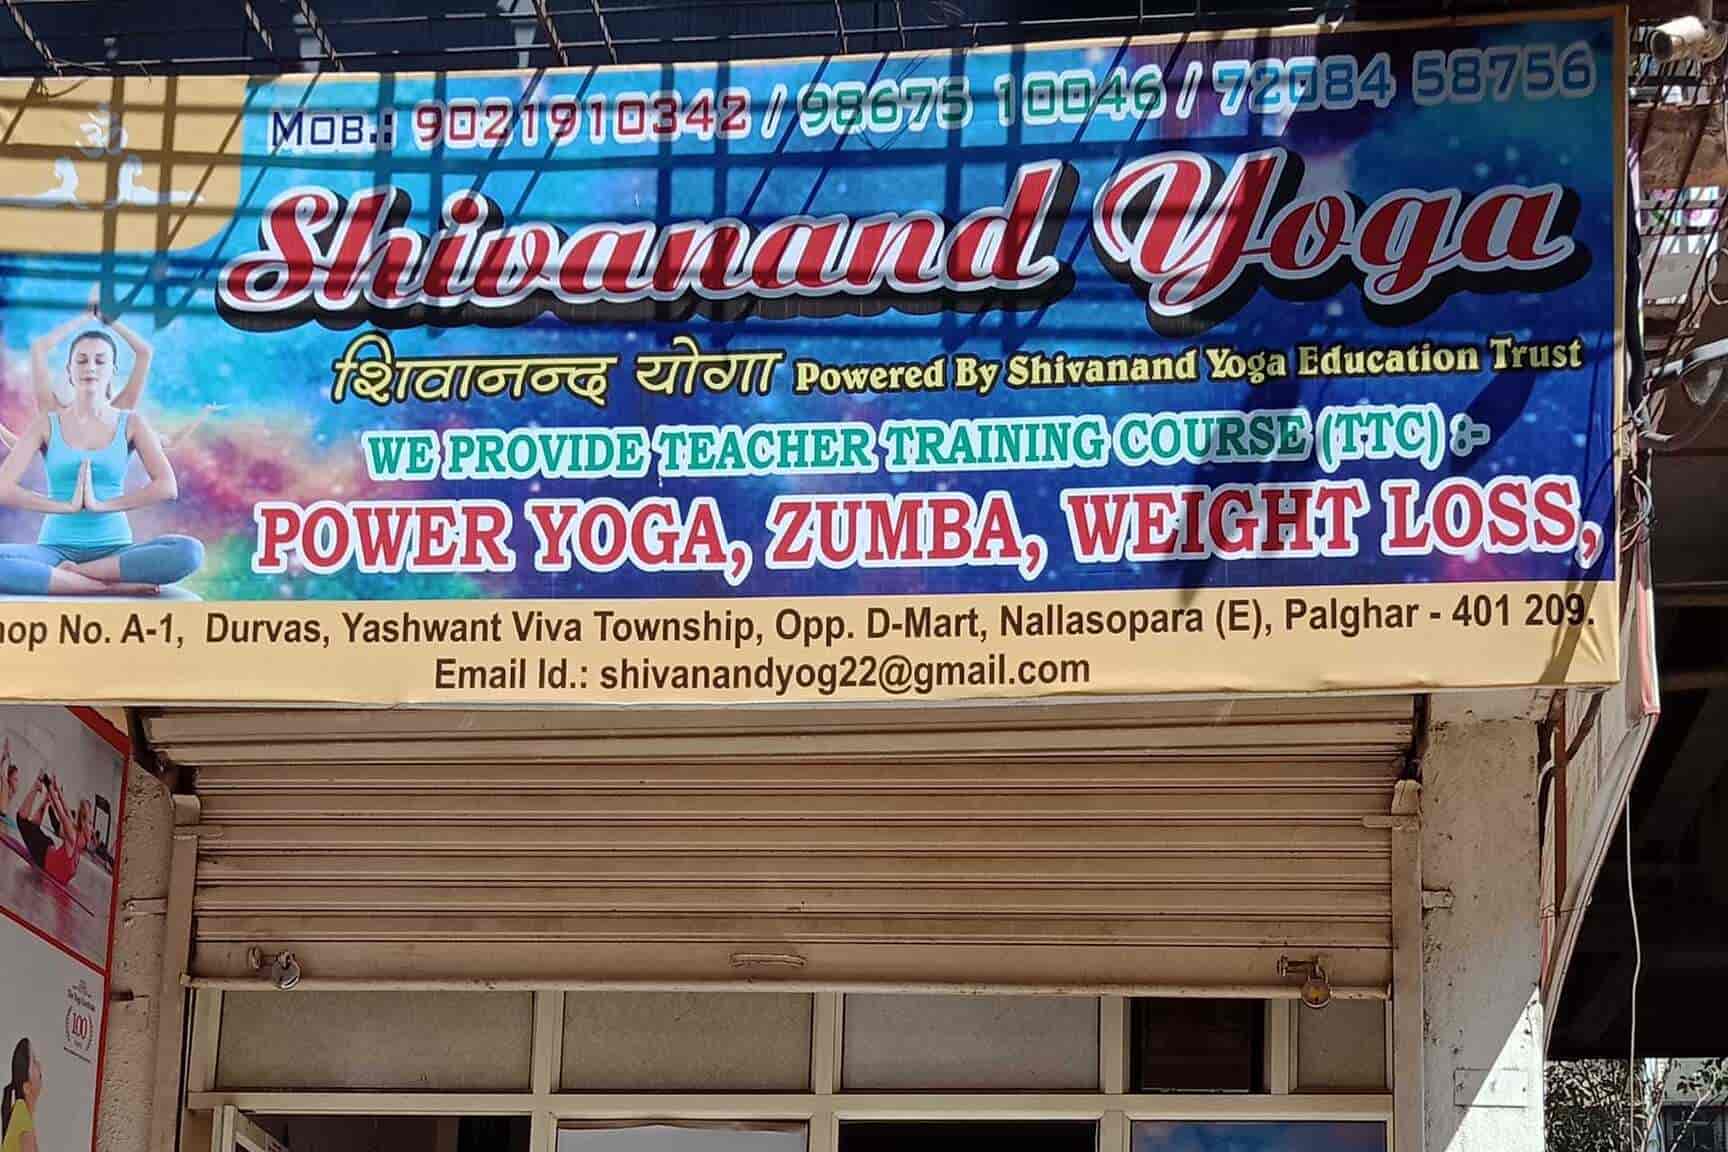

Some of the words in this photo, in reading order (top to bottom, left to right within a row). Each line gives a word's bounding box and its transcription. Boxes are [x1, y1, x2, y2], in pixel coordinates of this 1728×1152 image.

[414, 92, 748, 145] 9021910342
[801, 78, 969, 132] 98675
[996, 69, 1163, 121] 10046
[1214, 57, 1393, 112] 72084
[1415, 45, 1593, 101] 58756
[218, 160, 1060, 312] Shivanand
[1093, 148, 1574, 315] Yoga
[333, 334, 617, 405] शिवानन्द
[636, 336, 784, 395] योगा
[795, 358, 945, 392] Powered
[955, 357, 998, 394] By
[1007, 350, 1198, 386] Shivanand
[1206, 347, 1287, 385] Yoga
[1298, 343, 1479, 376] Education
[1490, 338, 1583, 370] Trust
[367, 435, 433, 475] WE
[447, 432, 645, 473] PROVIDE
[658, 428, 872, 470] TEACHER
[885, 421, 1105, 467] TRAINING
[1119, 414, 1305, 460] COURSE
[1322, 410, 1438, 467] (TTC)
[256, 505, 509, 569] POWER
[531, 502, 748, 579] YOGA,
[771, 497, 1041, 574] ZUMBA,
[1066, 486, 1362, 558] WEIGHT
[1387, 482, 1598, 563] LOSS,
[0, 618, 48, 652] op
[58, 613, 111, 645] No.
[120, 612, 185, 649] A-1,
[205, 611, 330, 649] Durvas,
[341, 610, 503, 643] Yashwant
[511, 610, 583, 642] Viva
[593, 609, 763, 649] Township,
[775, 607, 855, 648] Opp.
[866, 605, 988, 643] D-Mart,
[999, 604, 1203, 642] Nallasopara
[1215, 599, 1272, 640] (E),
[1285, 597, 1420, 638] Palghar
[1451, 594, 1511, 628] 401
[1524, 593, 1595, 627] 209.
[434, 657, 527, 690] Email
[599, 653, 1091, 697] shivanandyog22@gmail.com
